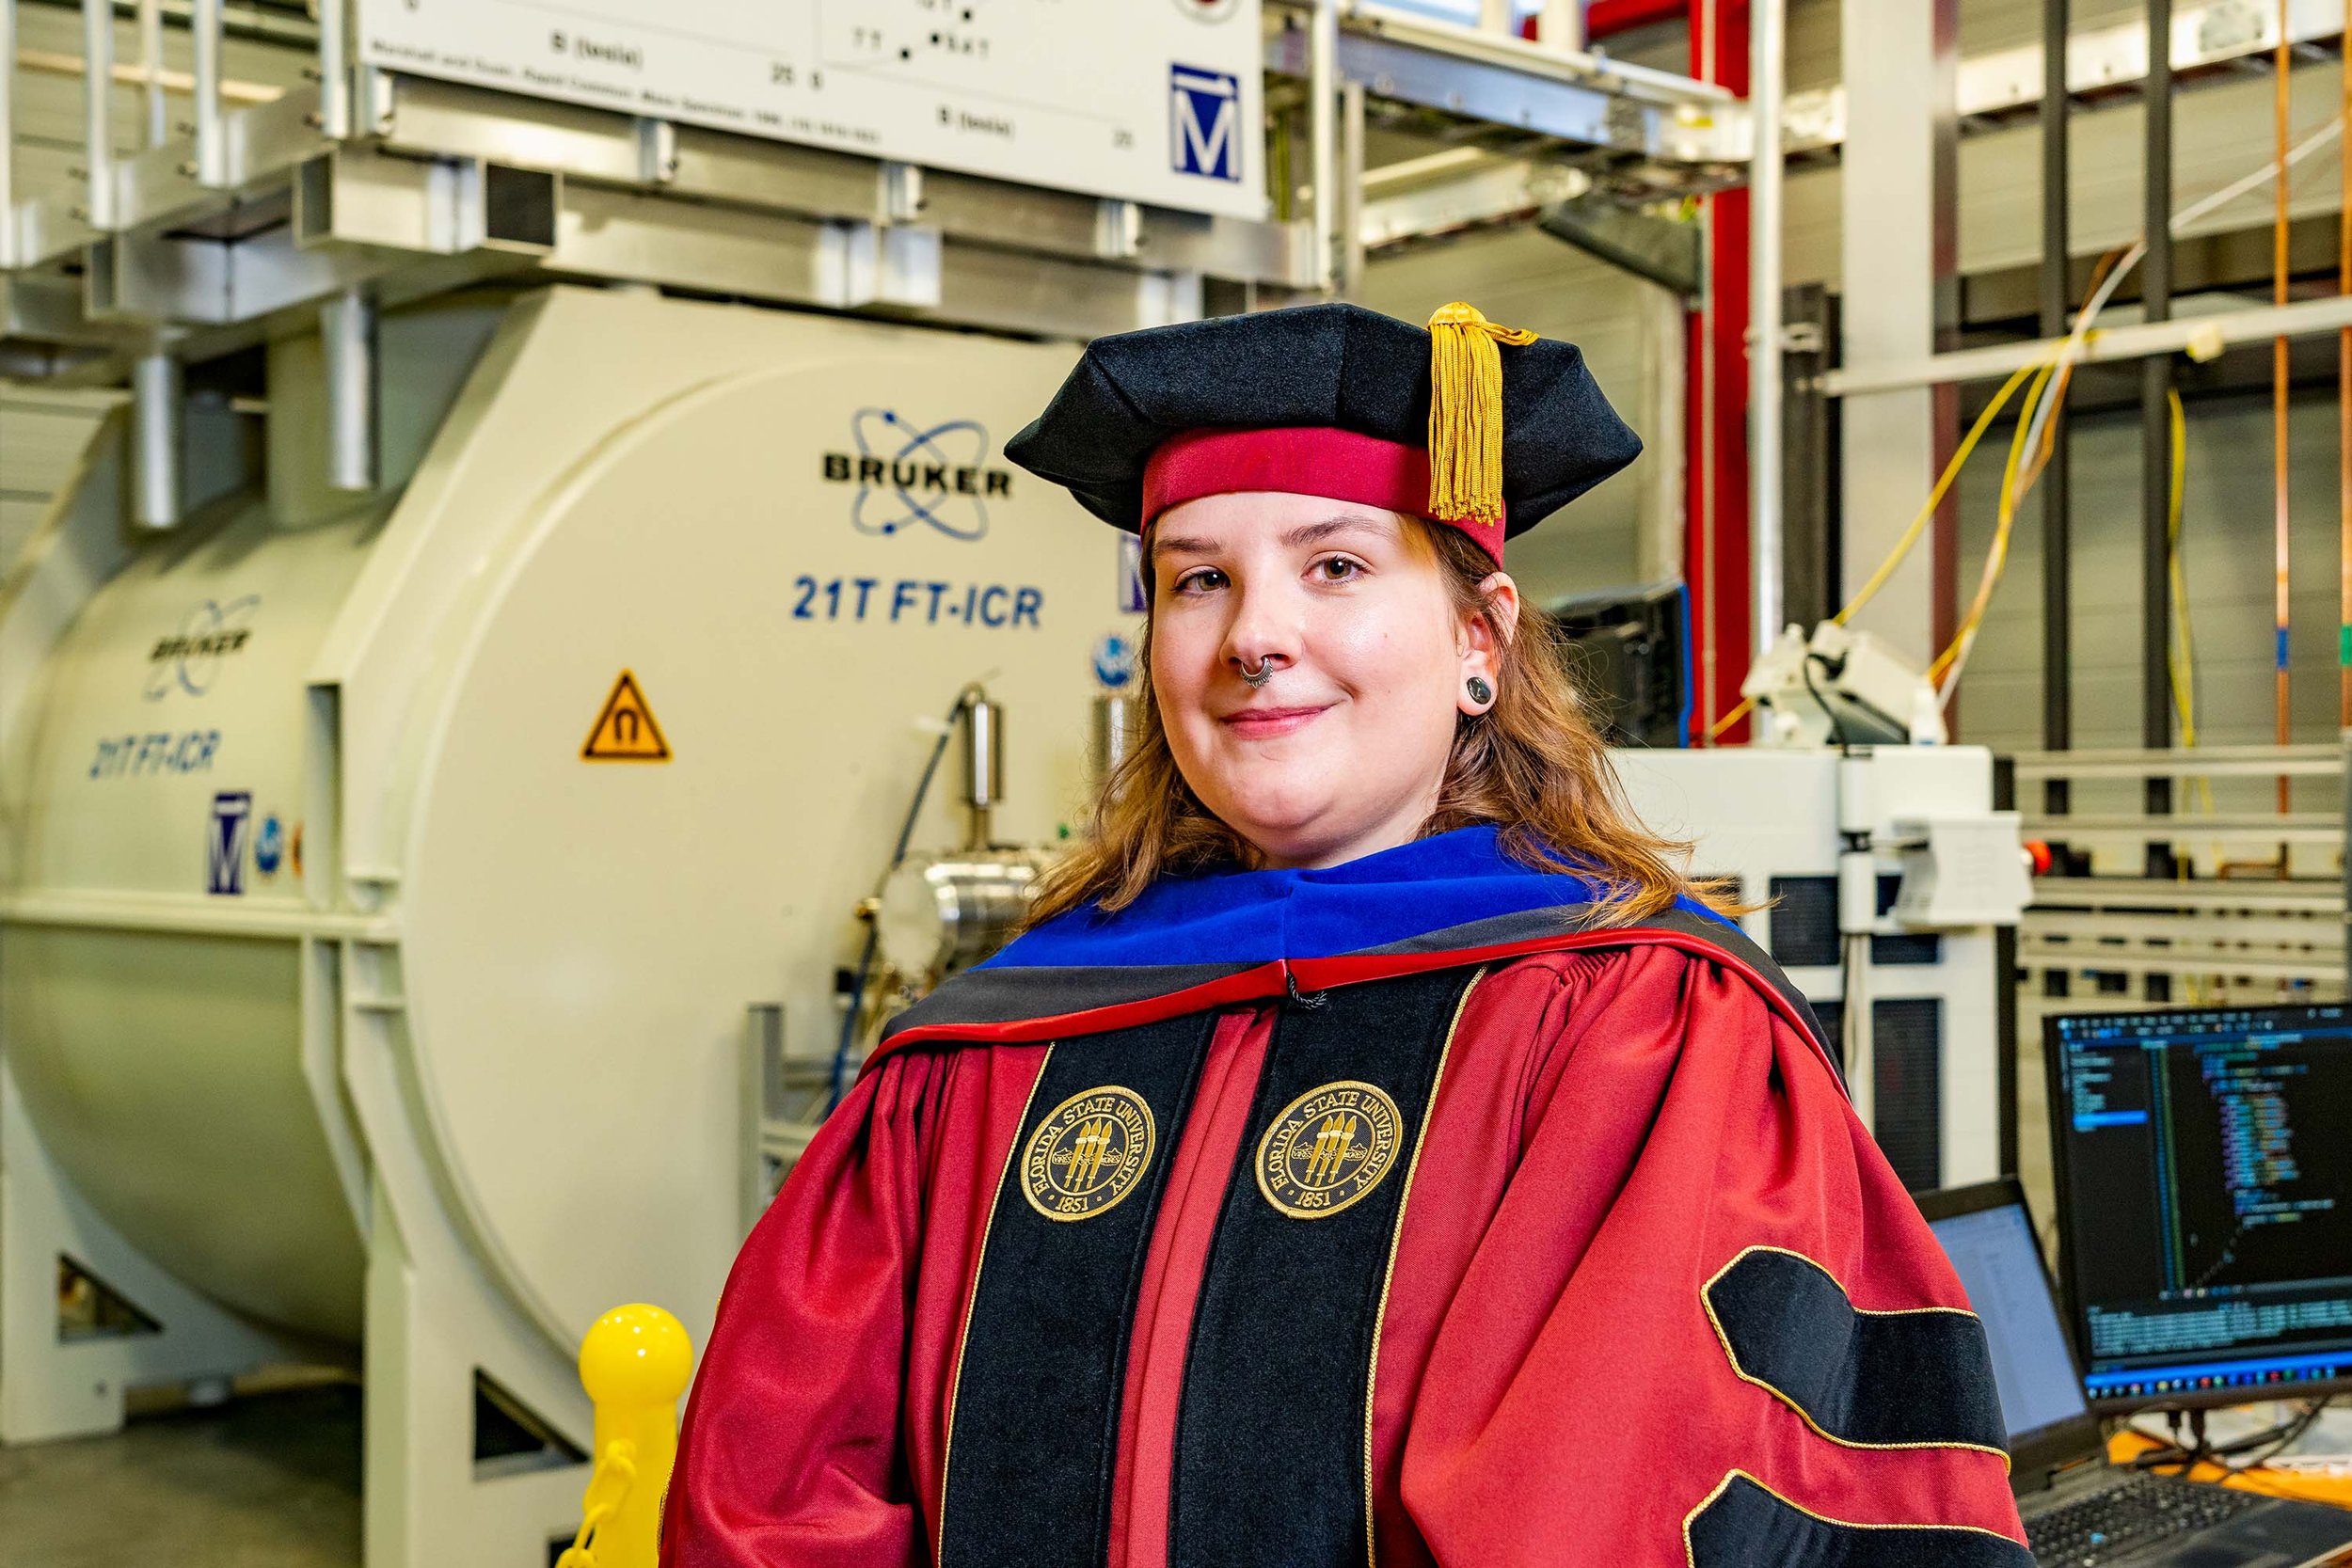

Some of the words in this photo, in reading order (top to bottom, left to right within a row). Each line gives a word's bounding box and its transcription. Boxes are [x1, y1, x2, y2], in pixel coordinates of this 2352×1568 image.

[823, 451, 1014, 498] BRUKER
[792, 575, 877, 622] 21T
[889, 579, 1044, 629] FT-ICR
[1029, 1125, 1063, 1196] FLORIDA
[1063, 1097, 1115, 1125] STATE
[1109, 1100, 1145, 1196] UNIVERSITY
[1267, 1119, 1304, 1191] FLORIDA
[1303, 1091, 1359, 1118] STATE
[1353, 1095, 1393, 1190] UNIVERSITY
[1055, 1196, 1089, 1212] 1851
[1295, 1191, 1331, 1207] 1851
